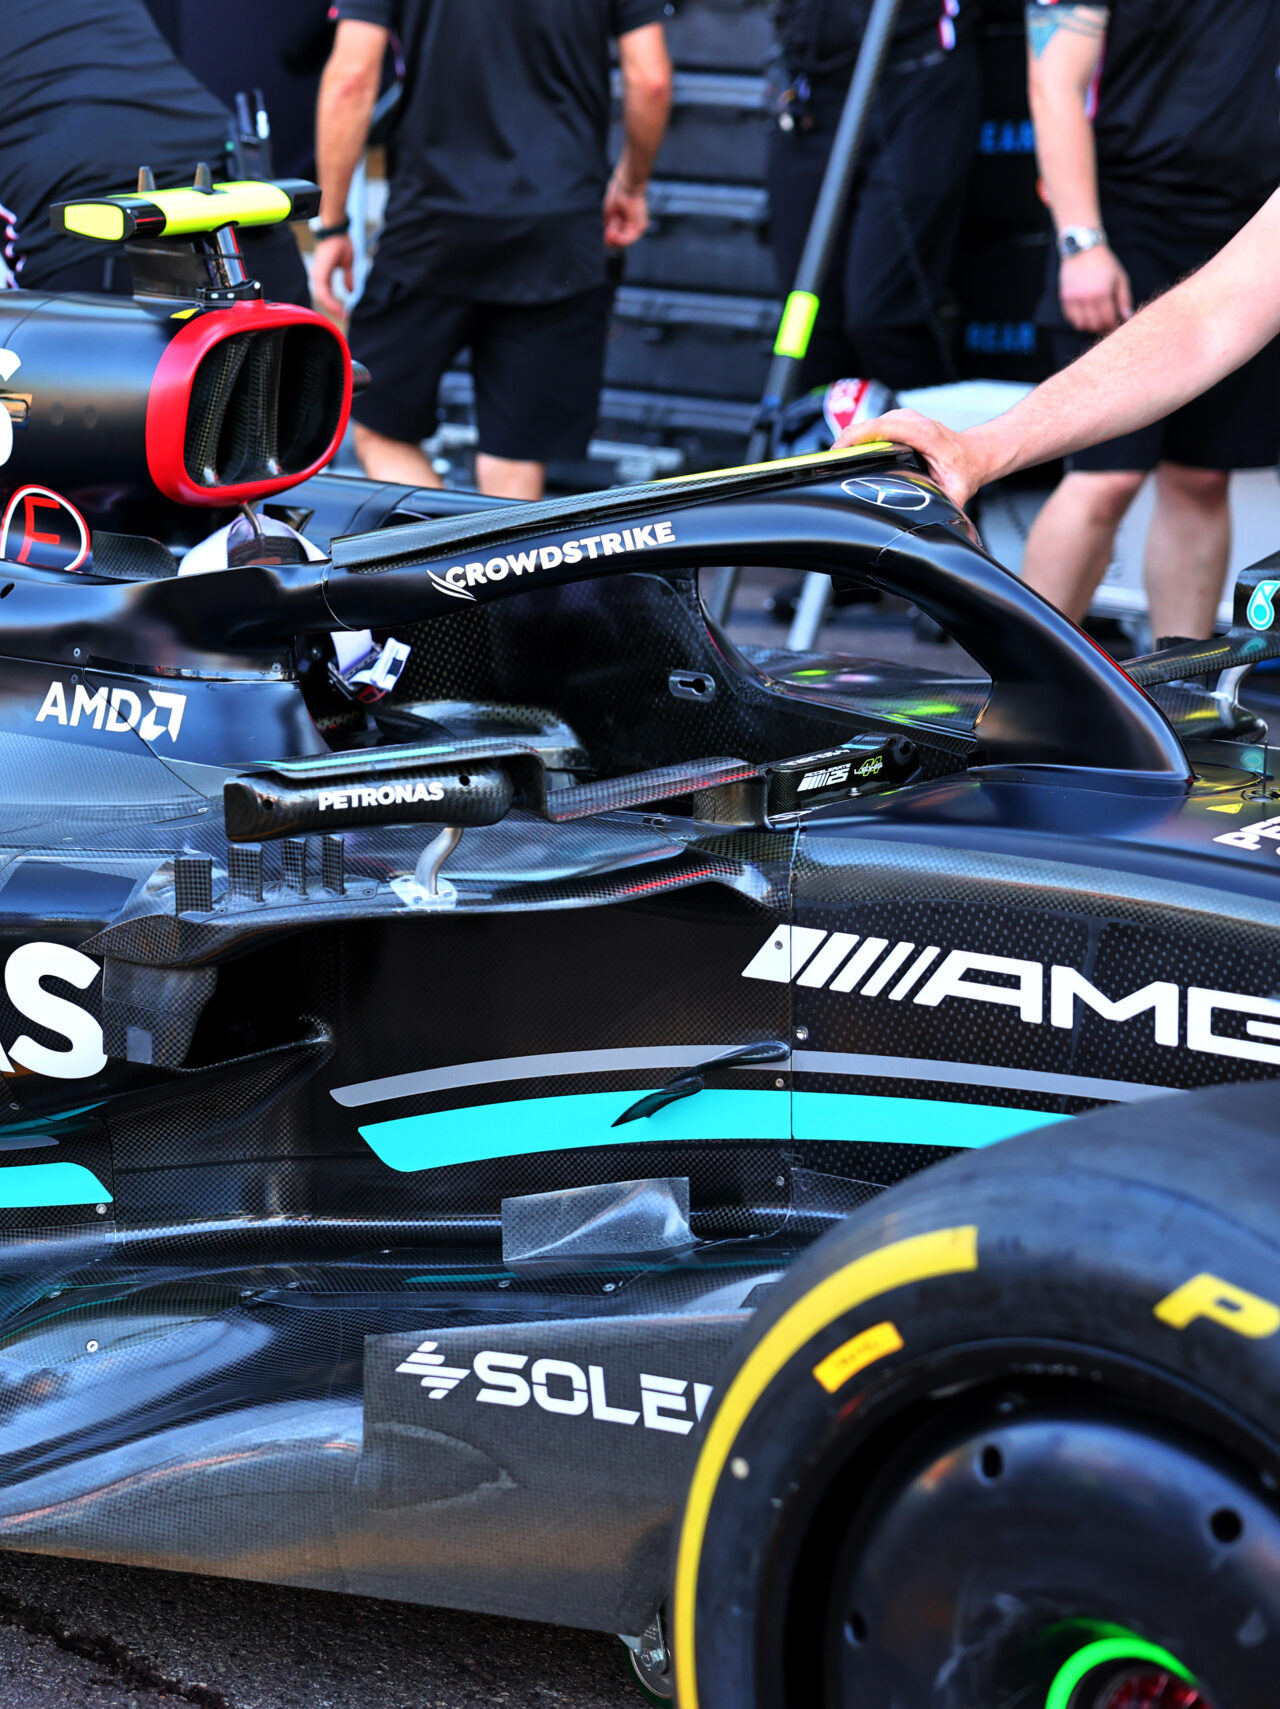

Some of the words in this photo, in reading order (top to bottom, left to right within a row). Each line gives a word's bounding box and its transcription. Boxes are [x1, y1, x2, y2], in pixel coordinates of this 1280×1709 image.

[445, 521, 676, 588] CROWDSTRIKE
[35, 681, 142, 733] AMD
[318, 781, 445, 811] PETRONAS
[912, 949, 1280, 1065] AMG
[1152, 1271, 1280, 1340] P
